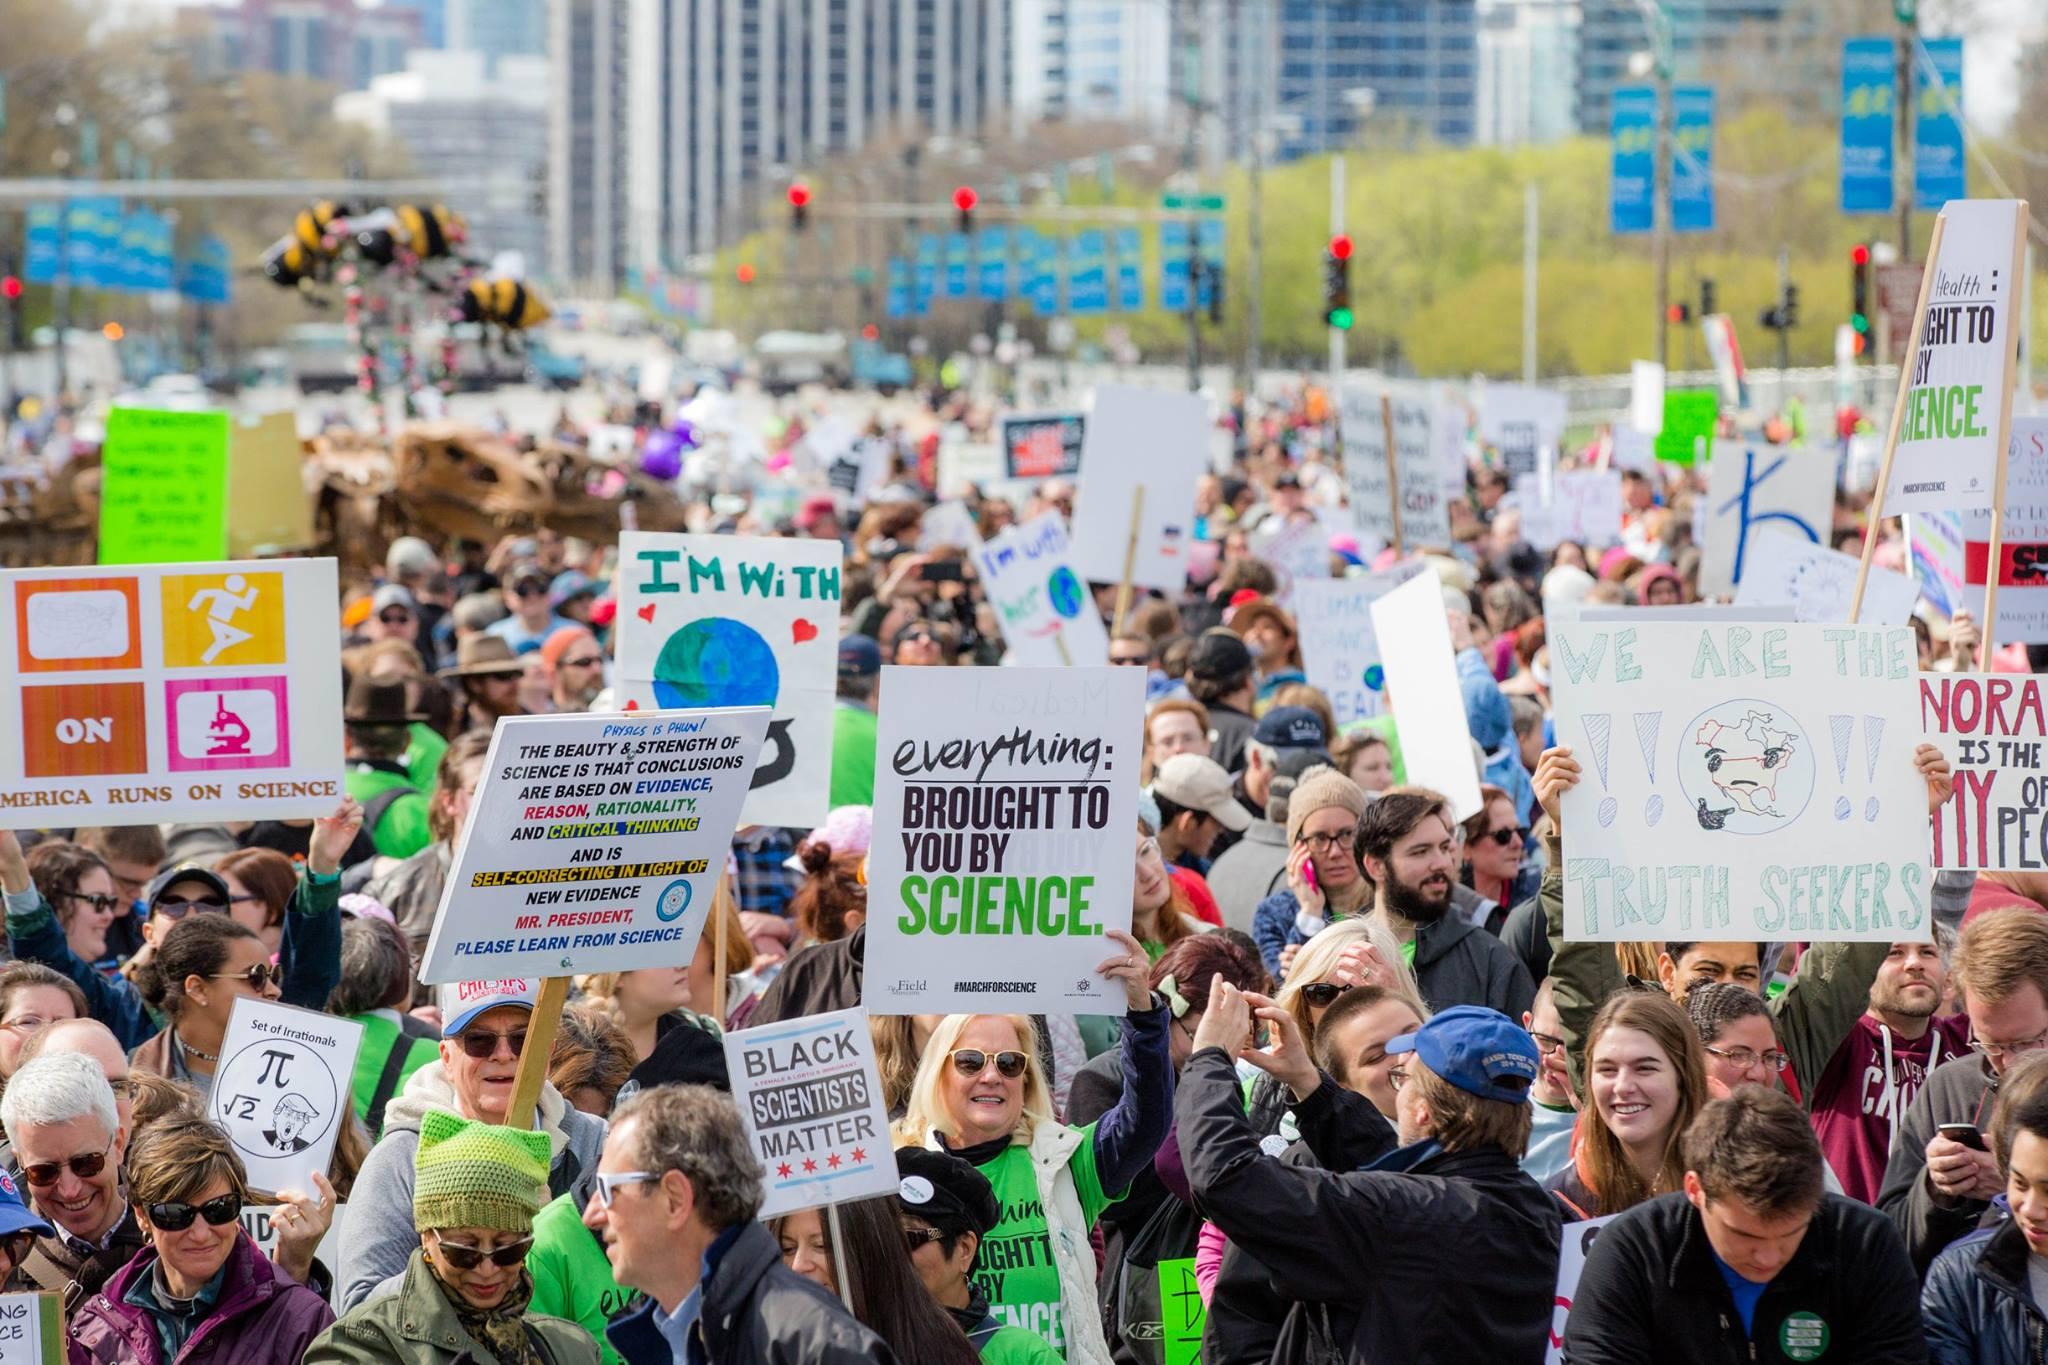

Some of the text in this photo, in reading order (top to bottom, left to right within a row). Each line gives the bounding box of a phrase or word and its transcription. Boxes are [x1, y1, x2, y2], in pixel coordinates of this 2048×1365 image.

[1967, 305, 1995, 344] TO
[1915, 349, 1932, 386] BY
[1900, 385, 1987, 444] CIENCE.
[637, 546, 726, 594] I'M
[1556, 626, 1910, 685] WE ARE THE
[1920, 678, 2047, 736] NORA
[55, 717, 113, 745] ON
[604, 725, 646, 737] PHYSICS
[653, 724, 662, 734] IS
[519, 736, 741, 759] THE BEAUTY & STRENGTH OF
[892, 726, 1113, 786] everything:
[1959, 740, 2041, 769] IS THE
[502, 755, 744, 780] SCIENCE IS THAT CONCLUSIONS
[107, 786, 172, 804] RUNS
[188, 784, 222, 801] ON
[238, 780, 337, 799] SCIENCE
[519, 777, 713, 800] ARE BASED ON EVIDENCE,
[524, 798, 697, 820] REASON, RATIONALITY,
[902, 785, 1109, 830] BROUGHT TO
[511, 818, 699, 840] AND CRITICAL THINKING
[570, 847, 622, 862] AND IS
[901, 832, 963, 873] YOU
[969, 832, 1010, 873] BY
[472, 859, 708, 887] SELF-CORRECTING IN LIGHT OF
[526, 886, 641, 905] NEW EVIDENCE
[898, 874, 1103, 936] SCIENCE.
[1567, 858, 1924, 936] TRUTH SEEKERS
[515, 909, 634, 929] MR. PRESIDENT,
[454, 928, 683, 955] PLEASE LEARN FROM SCIENCE
[898, 980, 927, 991] Field
[954, 982, 1037, 993] #MARCHFORSCIENCE
[251, 1019, 337, 1048] Set of Irrationals
[743, 1029, 860, 1078] BLACK
[753, 1074, 867, 1124] SCIENTISTS
[760, 1115, 876, 1160] MATTER
